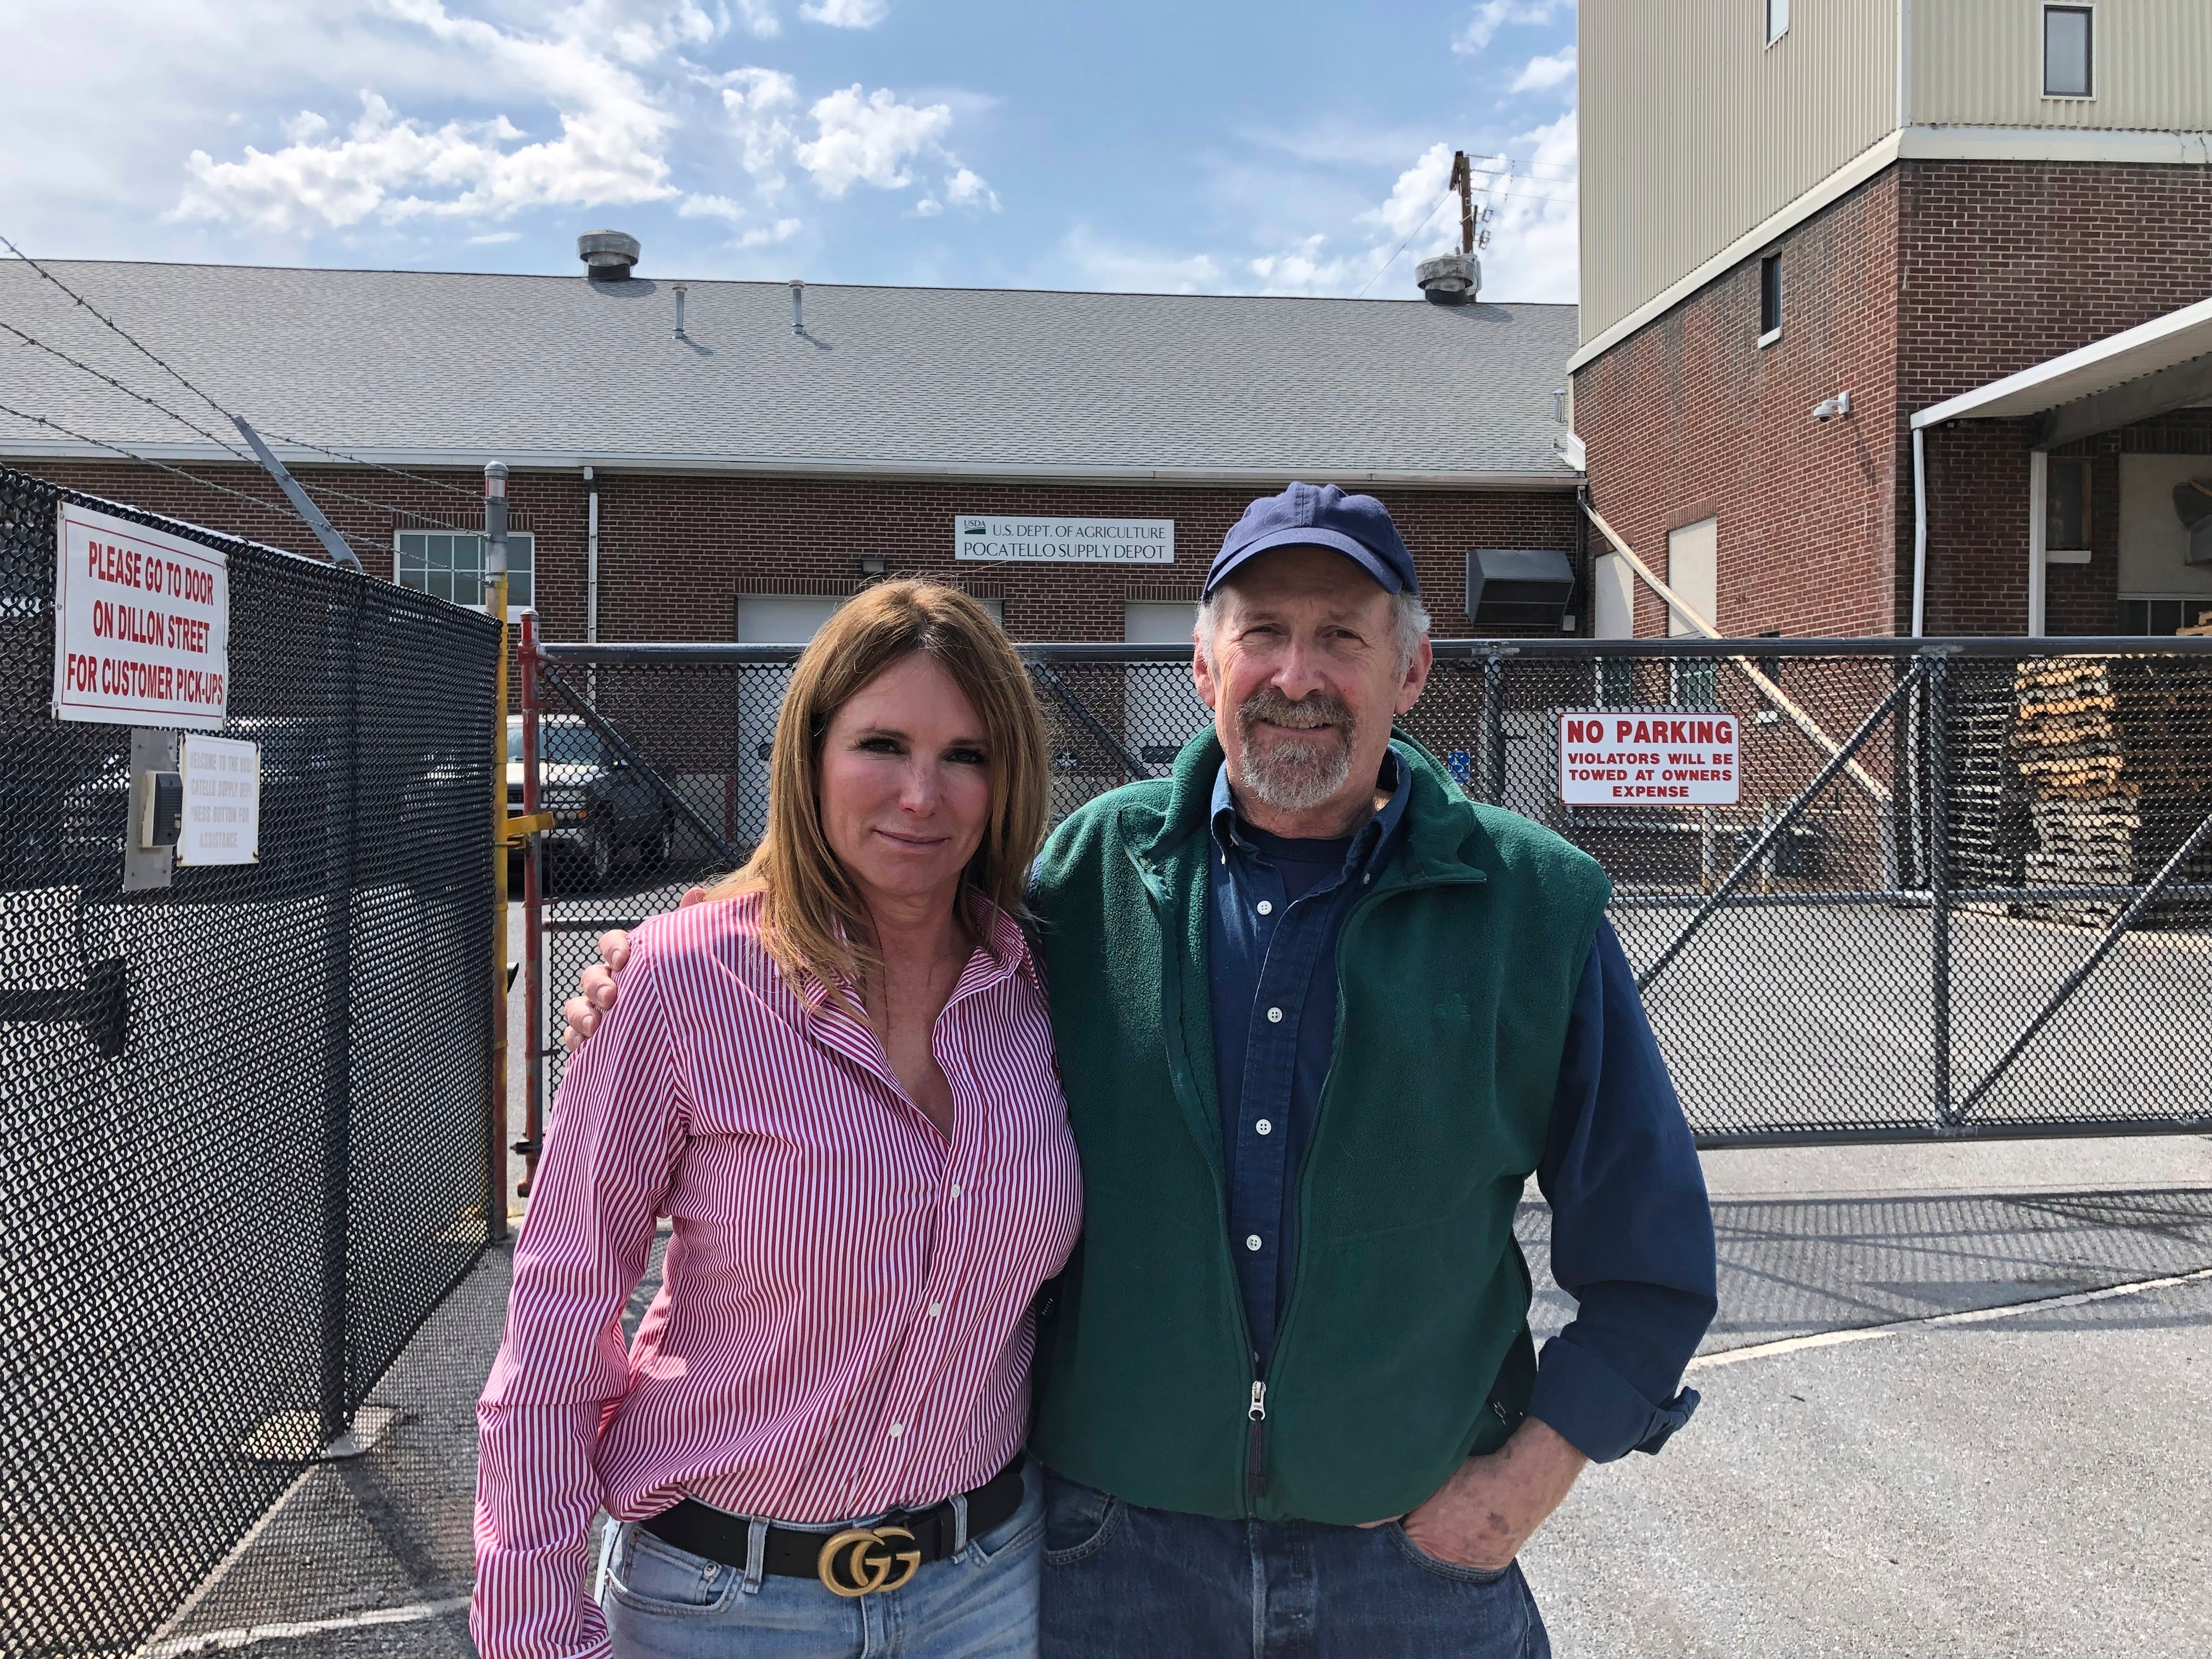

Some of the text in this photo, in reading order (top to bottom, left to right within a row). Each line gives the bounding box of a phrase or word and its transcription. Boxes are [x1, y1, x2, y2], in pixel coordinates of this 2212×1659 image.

[992, 524, 1166, 539] U.S. DEPT. OF AGRICULTURE
[964, 542, 1166, 559] POCATELLO SUPPLY DEPOT
[88, 541, 214, 606] PLEASE GO TO DOOR
[93, 600, 210, 654] ON DILLON STREET
[67, 653, 223, 706] FOR CUSTOMER PICK-UPS
[1567, 720, 1733, 744] NO PARKING
[1568, 753, 1733, 765] VIOLATORS WILL BE
[1568, 769, 1733, 781] TOWED AT OWNERS
[1612, 786, 1689, 798] EXPENSE
